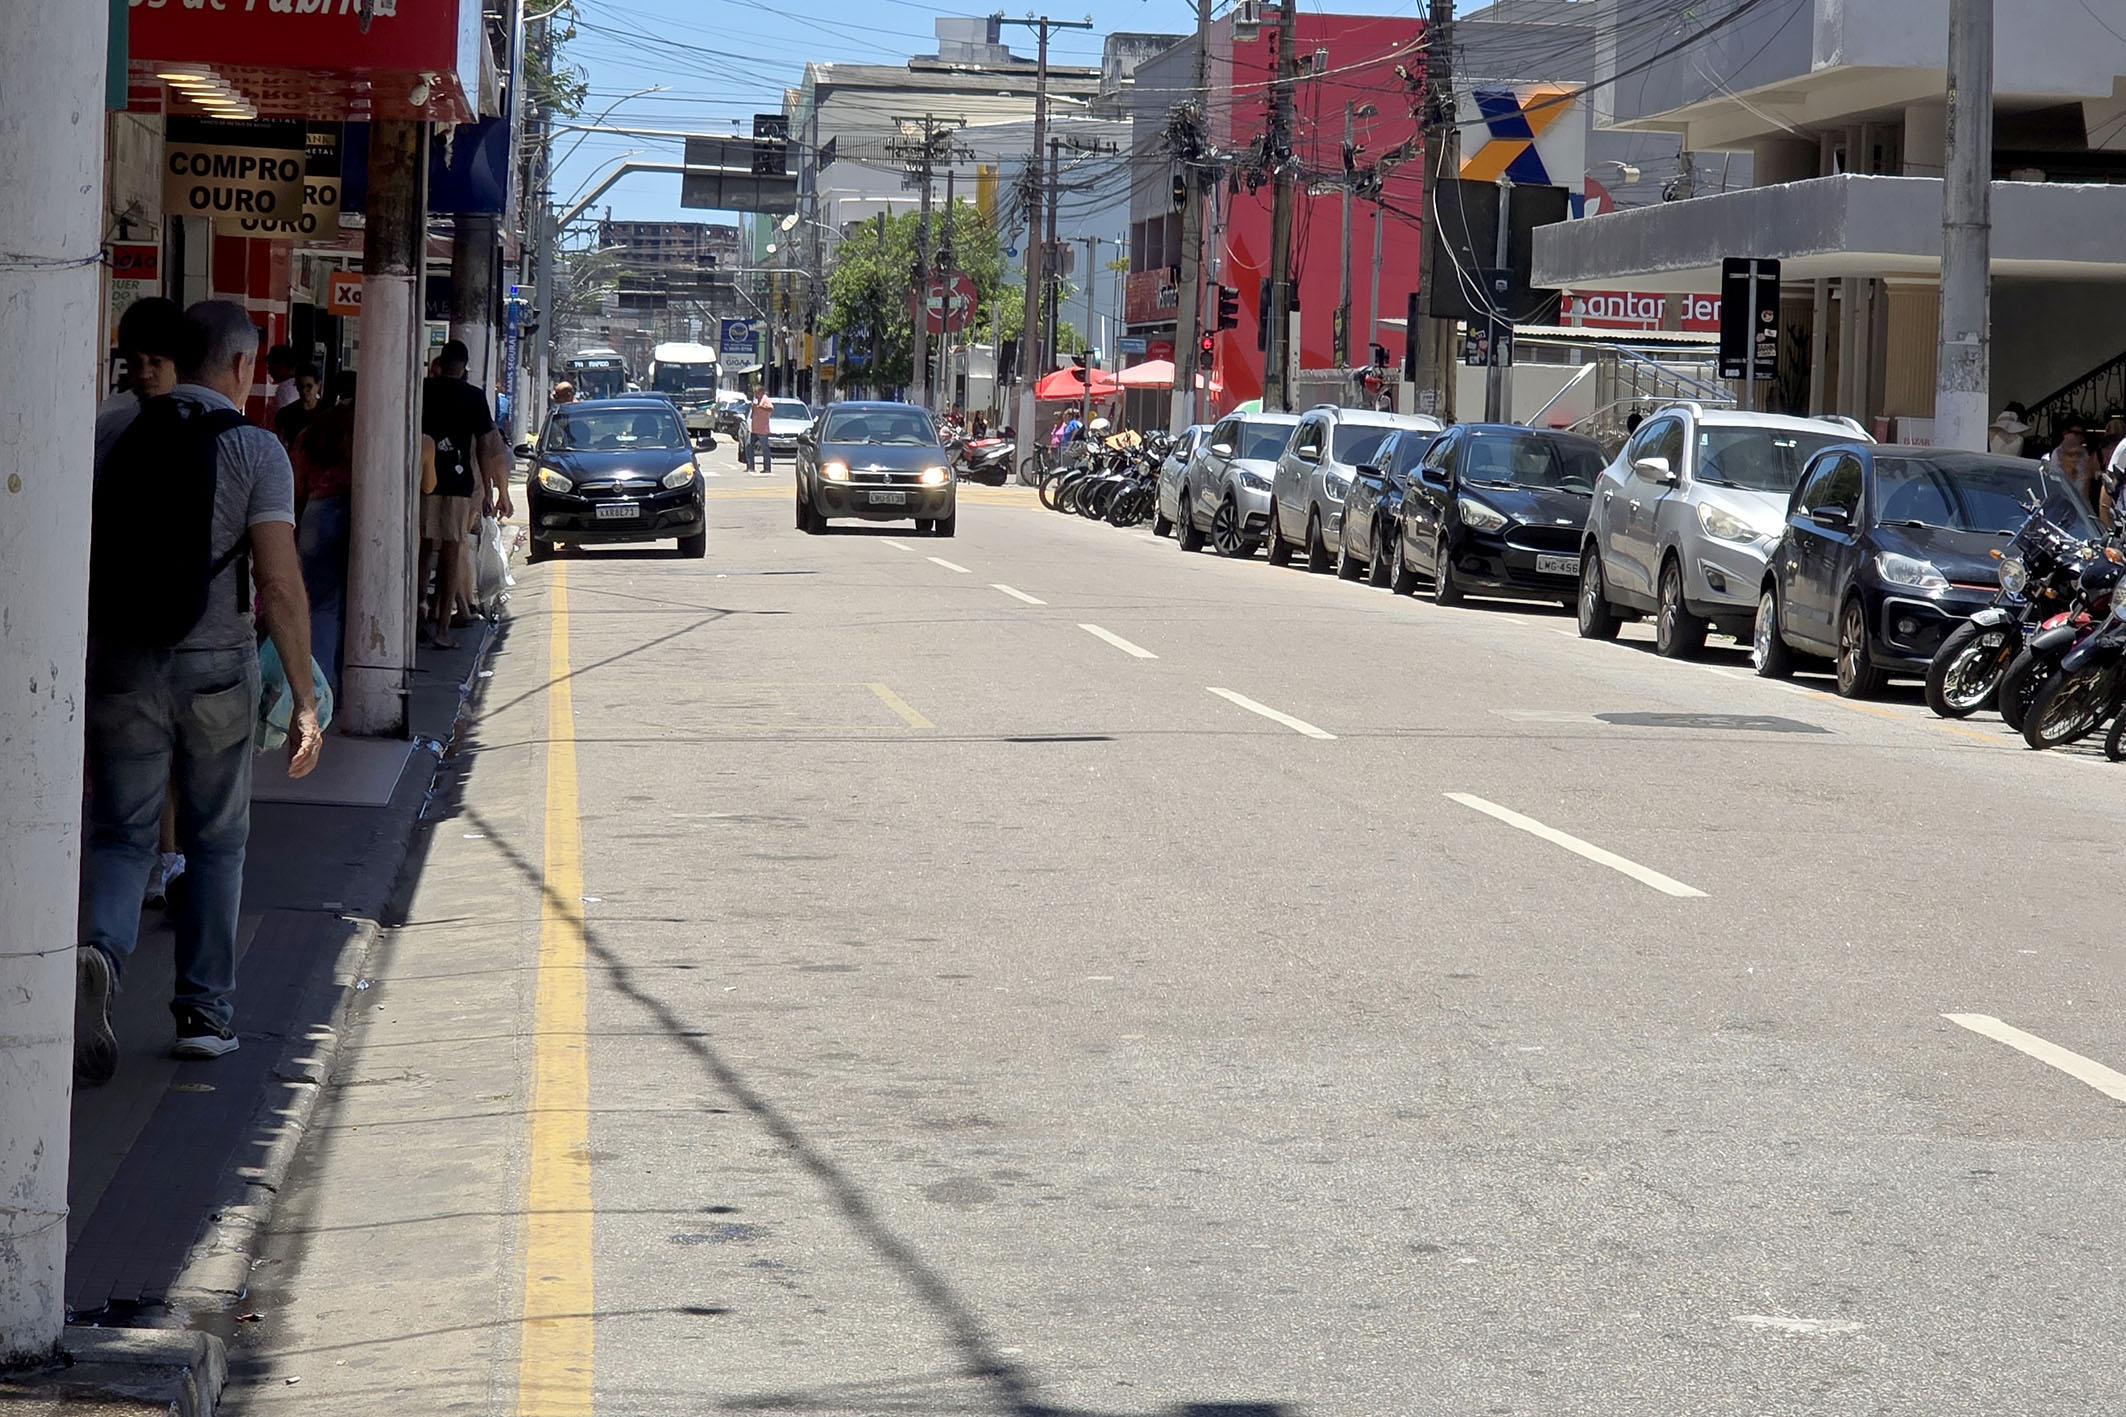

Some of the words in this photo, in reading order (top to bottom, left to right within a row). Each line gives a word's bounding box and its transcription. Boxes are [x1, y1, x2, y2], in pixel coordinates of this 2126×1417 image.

[169, 152, 300, 183] COMPRO
[189, 186, 276, 214] OURO
[1538, 560, 1579, 573] LMG-456
